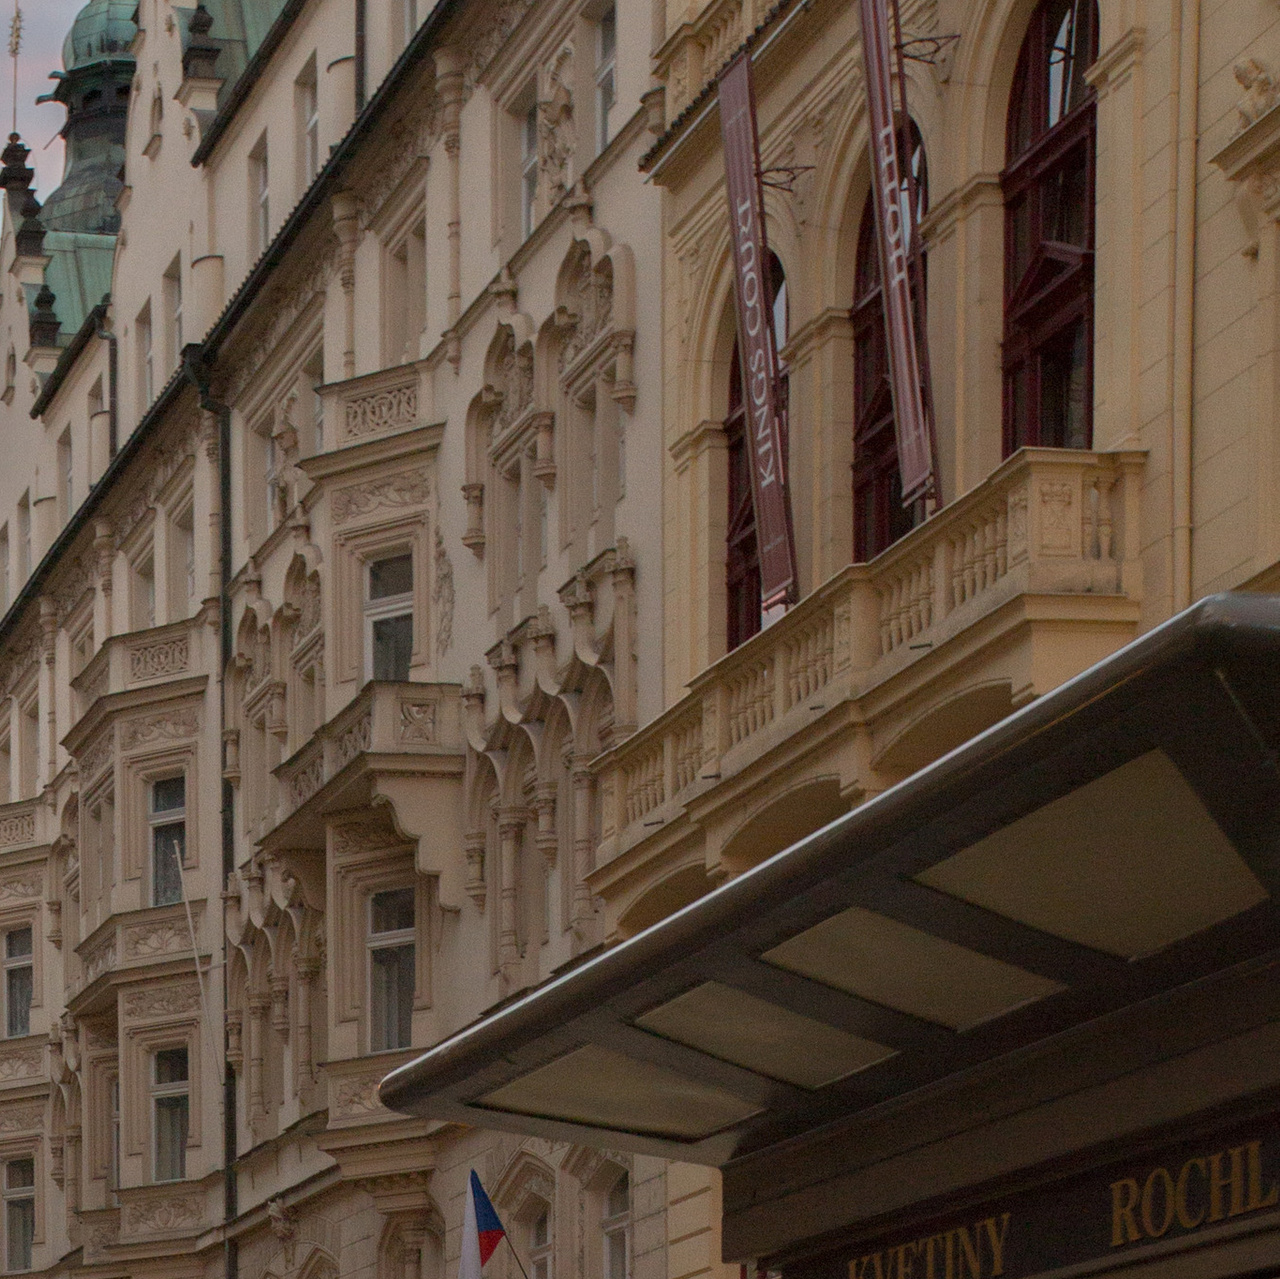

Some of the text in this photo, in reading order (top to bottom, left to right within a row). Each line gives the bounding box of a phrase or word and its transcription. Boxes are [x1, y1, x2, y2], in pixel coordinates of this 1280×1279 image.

[880, 126, 905, 288] HOTEL
[737, 196, 775, 488] KINGS COURT
